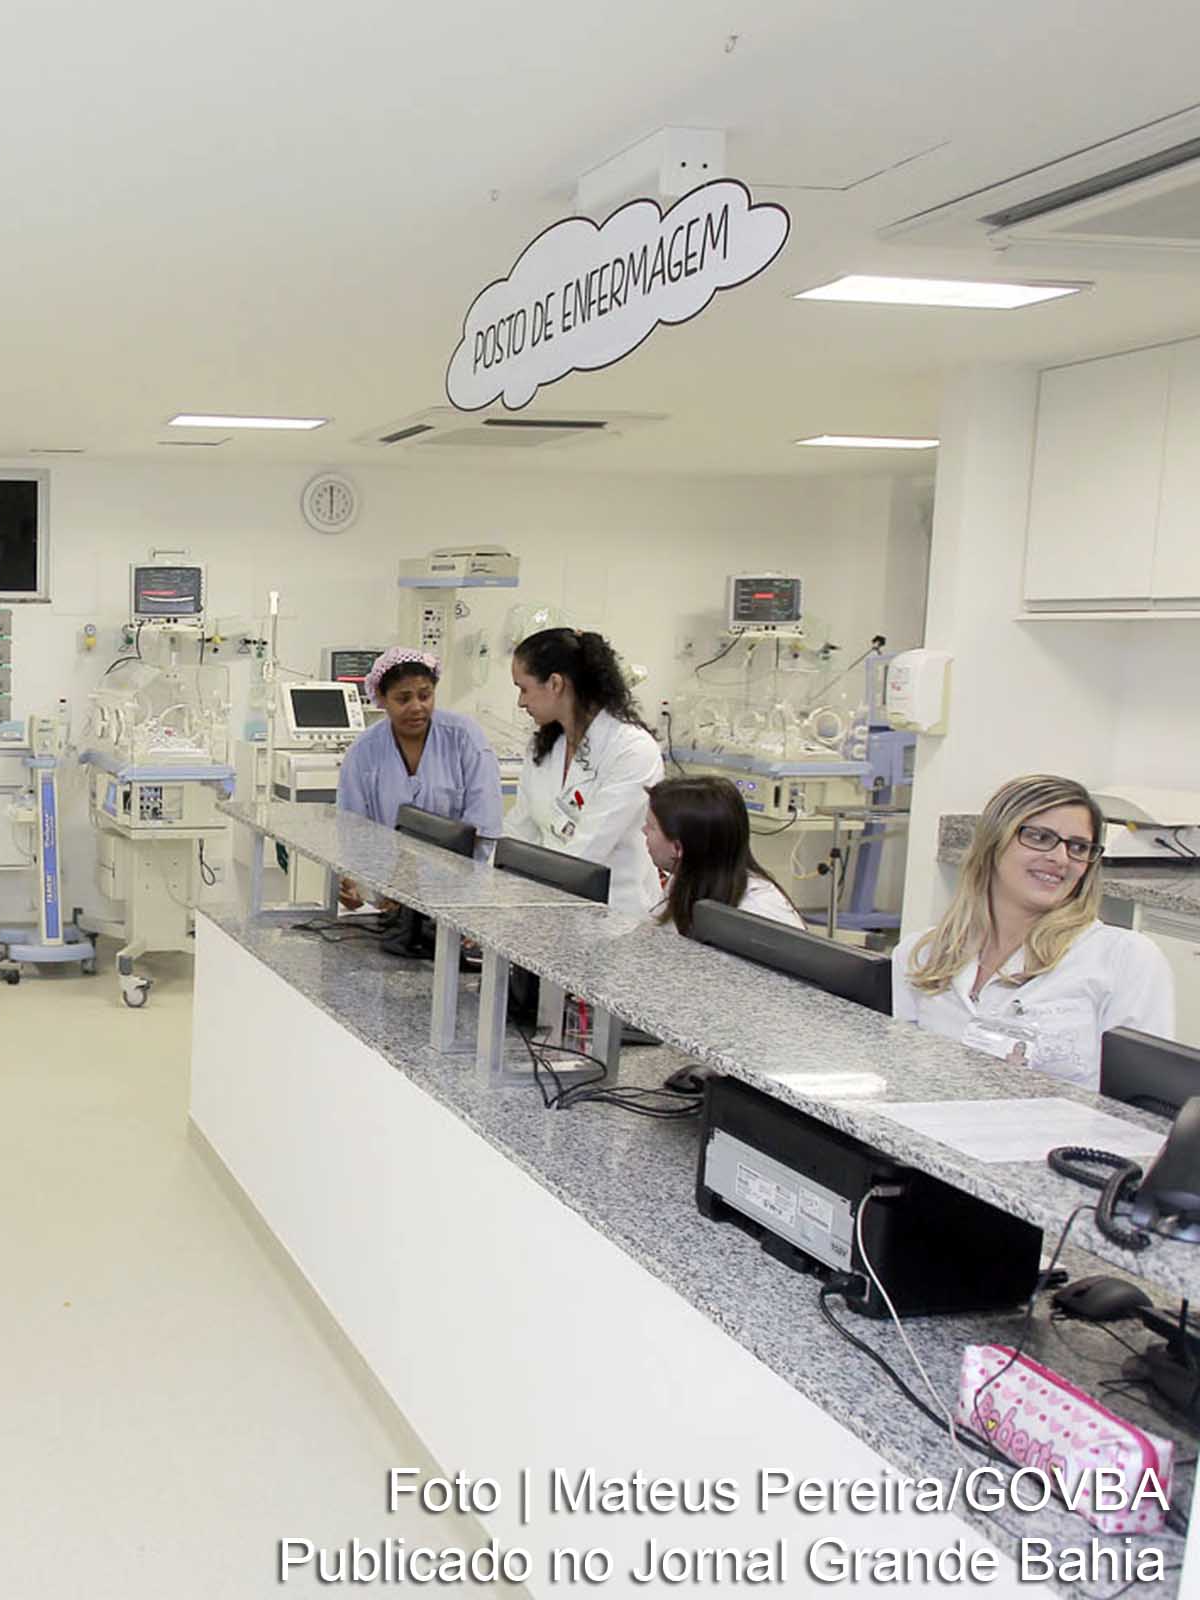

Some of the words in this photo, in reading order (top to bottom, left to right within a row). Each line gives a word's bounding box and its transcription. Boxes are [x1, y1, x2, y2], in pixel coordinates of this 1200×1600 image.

[472, 308, 527, 375] POSTO
[531, 292, 556, 347] DE
[561, 203, 730, 333] ENFERMAGEM
